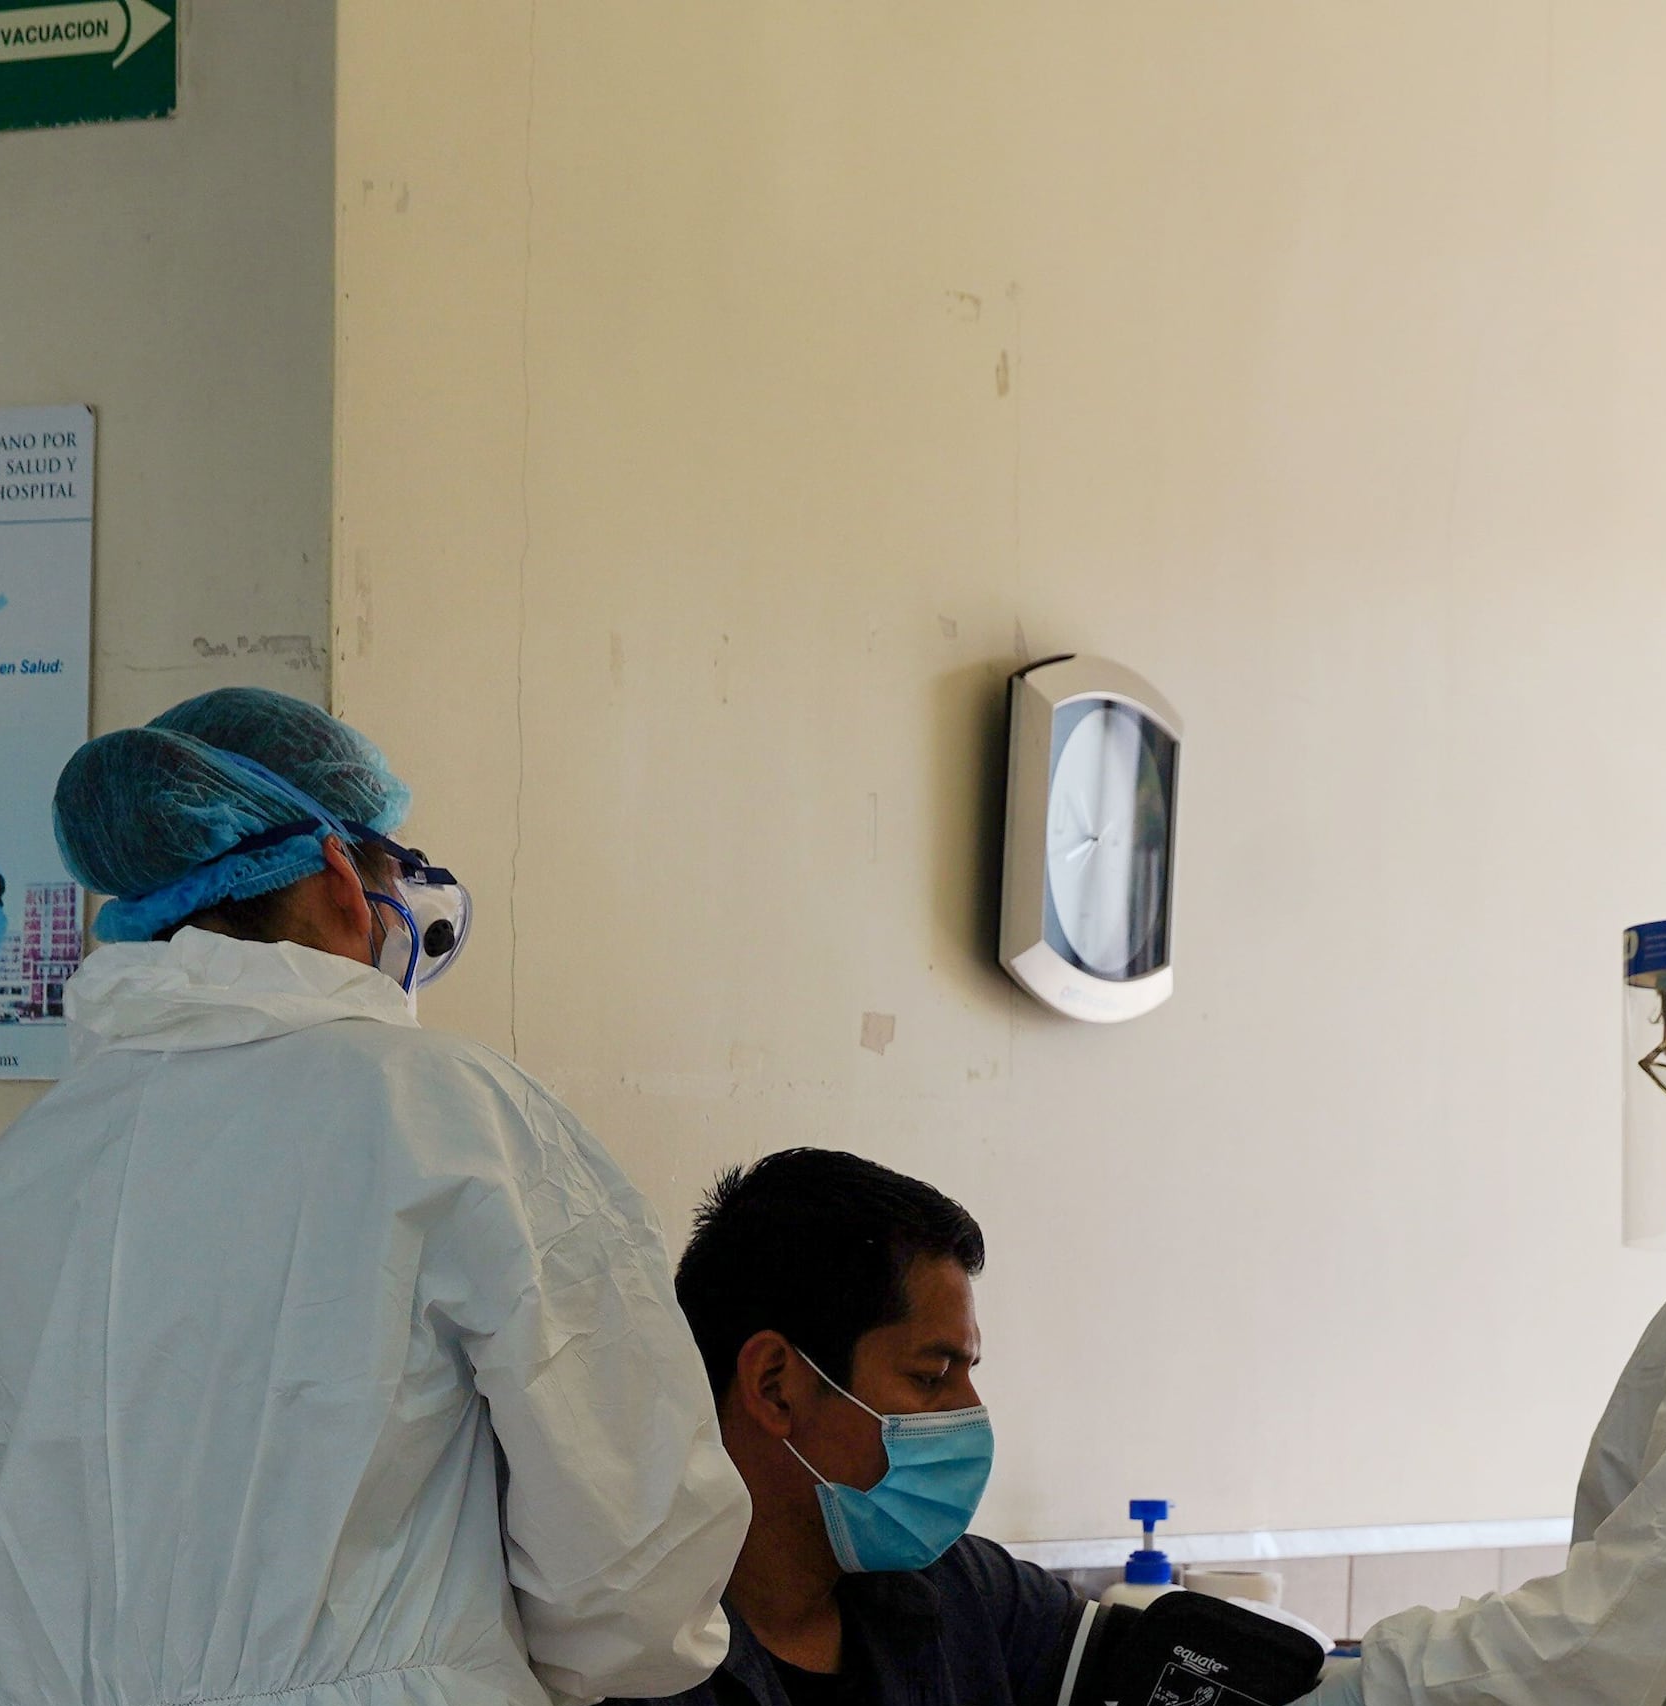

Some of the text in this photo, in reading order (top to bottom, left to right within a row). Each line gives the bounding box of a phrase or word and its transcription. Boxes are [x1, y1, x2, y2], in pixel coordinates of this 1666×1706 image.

[42, 432, 77, 449] POR
[6, 458, 61, 475] SALUD
[66, 457, 77, 472] Y
[0, 664, 16, 676] en
[1173, 1645, 1224, 1674] equate
